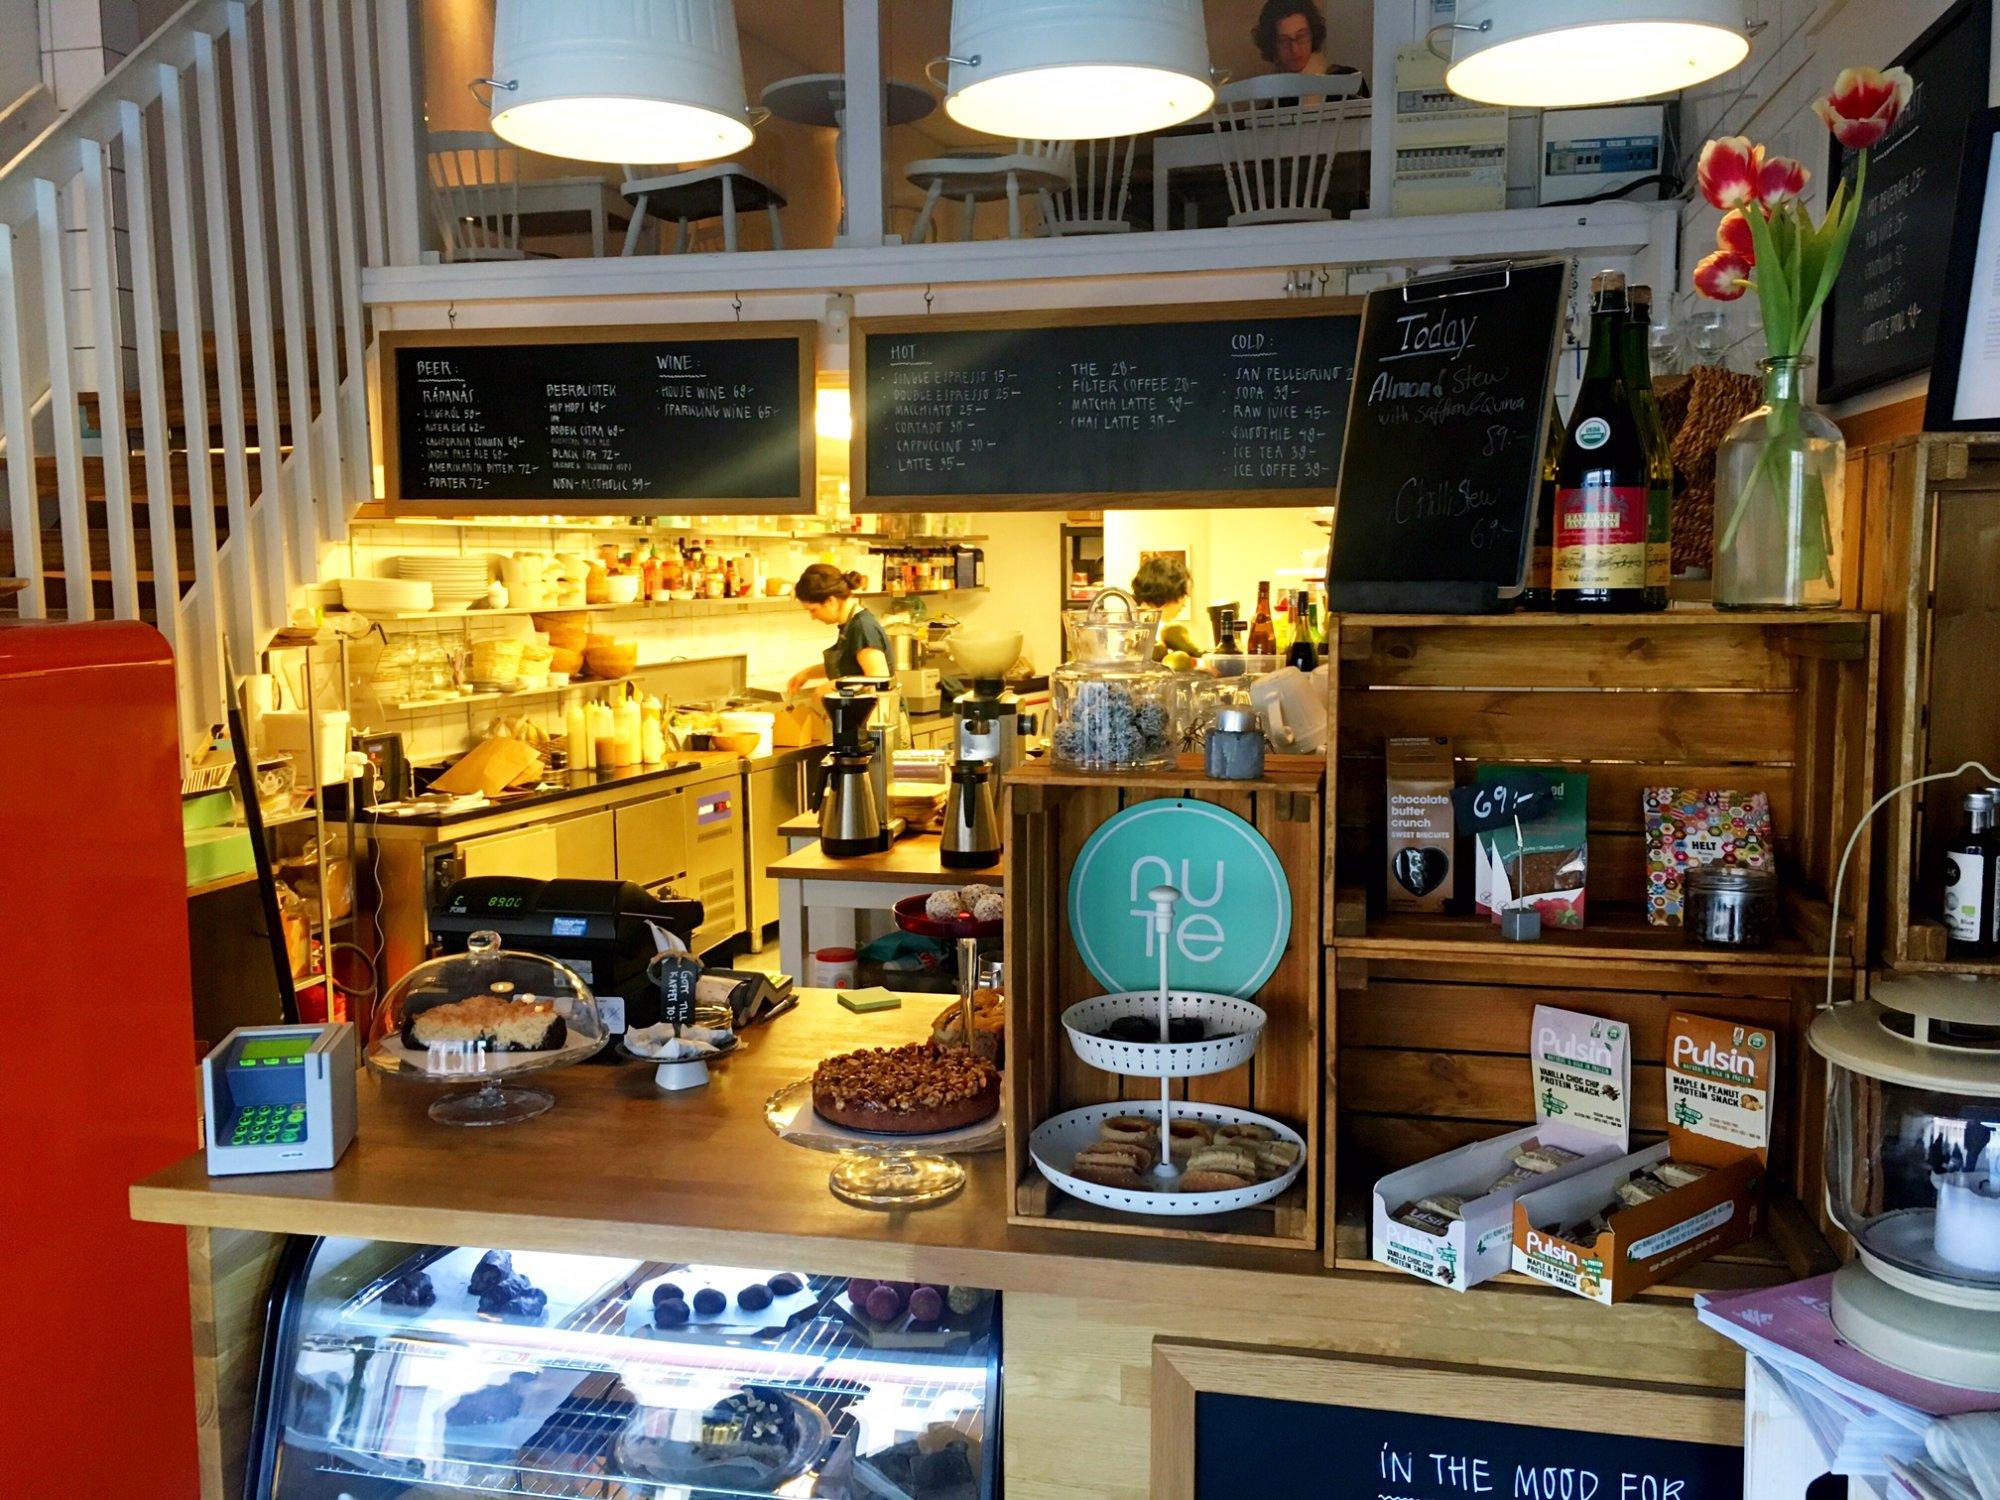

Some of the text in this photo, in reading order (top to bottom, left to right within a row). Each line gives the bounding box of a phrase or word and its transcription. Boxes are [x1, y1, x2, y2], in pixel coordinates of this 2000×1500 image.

[1396, 308, 1478, 361] Today
[1071, 362, 1099, 377] THE
[1234, 367, 1261, 380] SAN
[1266, 366, 1342, 381] PELLEGRINO
[662, 385, 692, 398] HOUSE
[697, 384, 726, 400] WINE
[1123, 377, 1169, 392] COFFEE
[1368, 366, 1510, 407] Almond Stew
[894, 388, 931, 401] DOUBLE
[936, 388, 990, 401] ESPRESSO
[722, 404, 752, 419] WINE
[895, 404, 953, 416] MACCHIATO
[1072, 397, 1116, 411] MATCHA
[1121, 397, 1158, 411] LATTE
[1233, 404, 1262, 418] RAW
[1104, 415, 1139, 430] LATTE
[1259, 445, 1284, 459] TEA
[898, 458, 933, 472] LATTE
[429, 477, 467, 489] PORTER
[1391, 794, 1449, 804] chocolate
[1473, 785, 1534, 819] 69:-
[1391, 806, 1425, 816] butter
[1391, 818, 1431, 827] crunch
[1692, 841, 1717, 850] HELT
[1538, 1027, 1612, 1068] Pulsin
[1673, 1035, 1755, 1078] Pulsin
[1540, 1067, 1600, 1088] VANILLA CHOC CHIP
[1540, 1075, 1600, 1097] PROTEIN SNACK
[1673, 1076, 1740, 1099] MAPLE & PEANUT
[1673, 1085, 1739, 1108] PROTEIN SNACK
[1527, 1231, 1578, 1266] Pulsin
[1387, 1255, 1412, 1270] PROTEIN
[1527, 1257, 1546, 1270] MAPLE
[1553, 1267, 1577, 1281] PEANUT
[1527, 1264, 1577, 1288] PROTEIN SNACK
[1429, 1453, 1493, 1493] THE
[1514, 1465, 1599, 1500] MOOD
[1621, 1472, 1685, 1500] FOR
